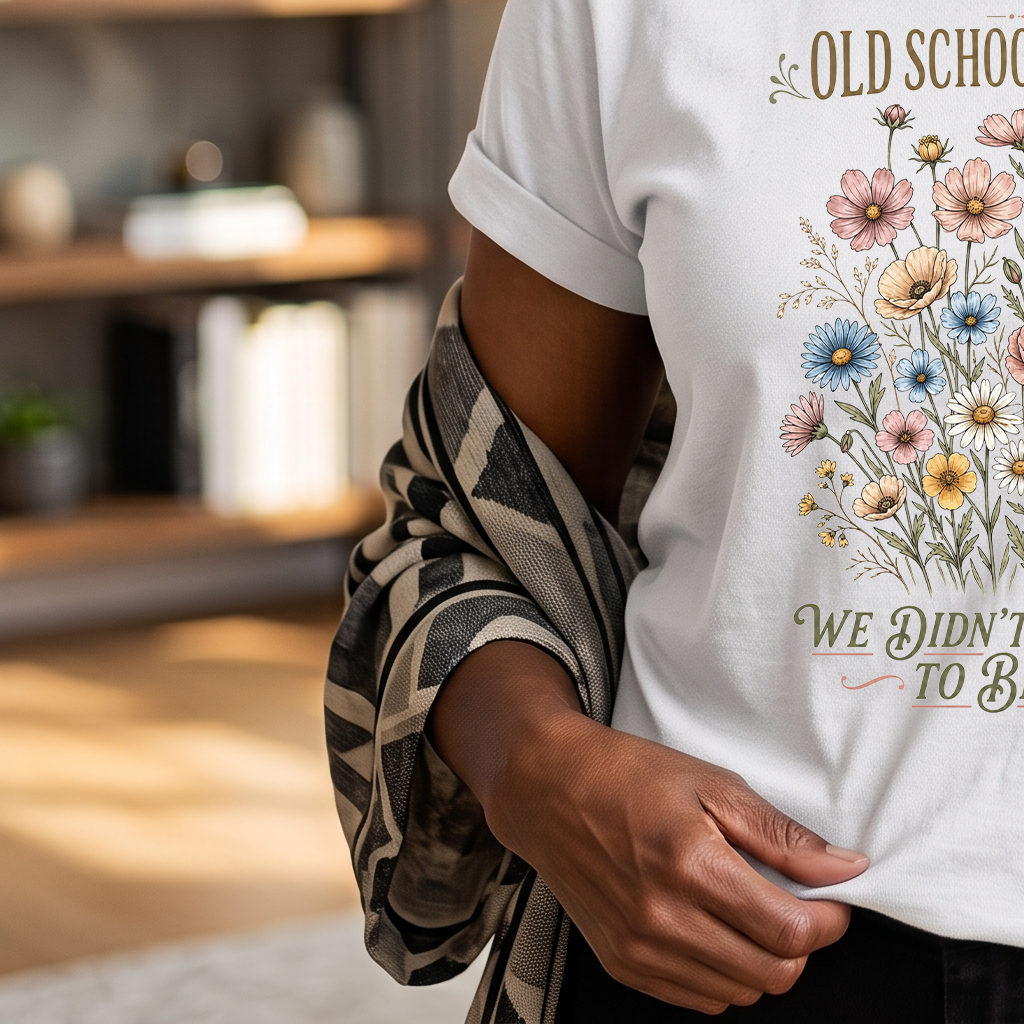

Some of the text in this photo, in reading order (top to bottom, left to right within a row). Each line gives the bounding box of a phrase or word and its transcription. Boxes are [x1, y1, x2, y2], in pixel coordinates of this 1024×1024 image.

[810, 29, 892, 100] OLD
[793, 603, 874, 648] WE
[915, 662, 966, 700] TO
